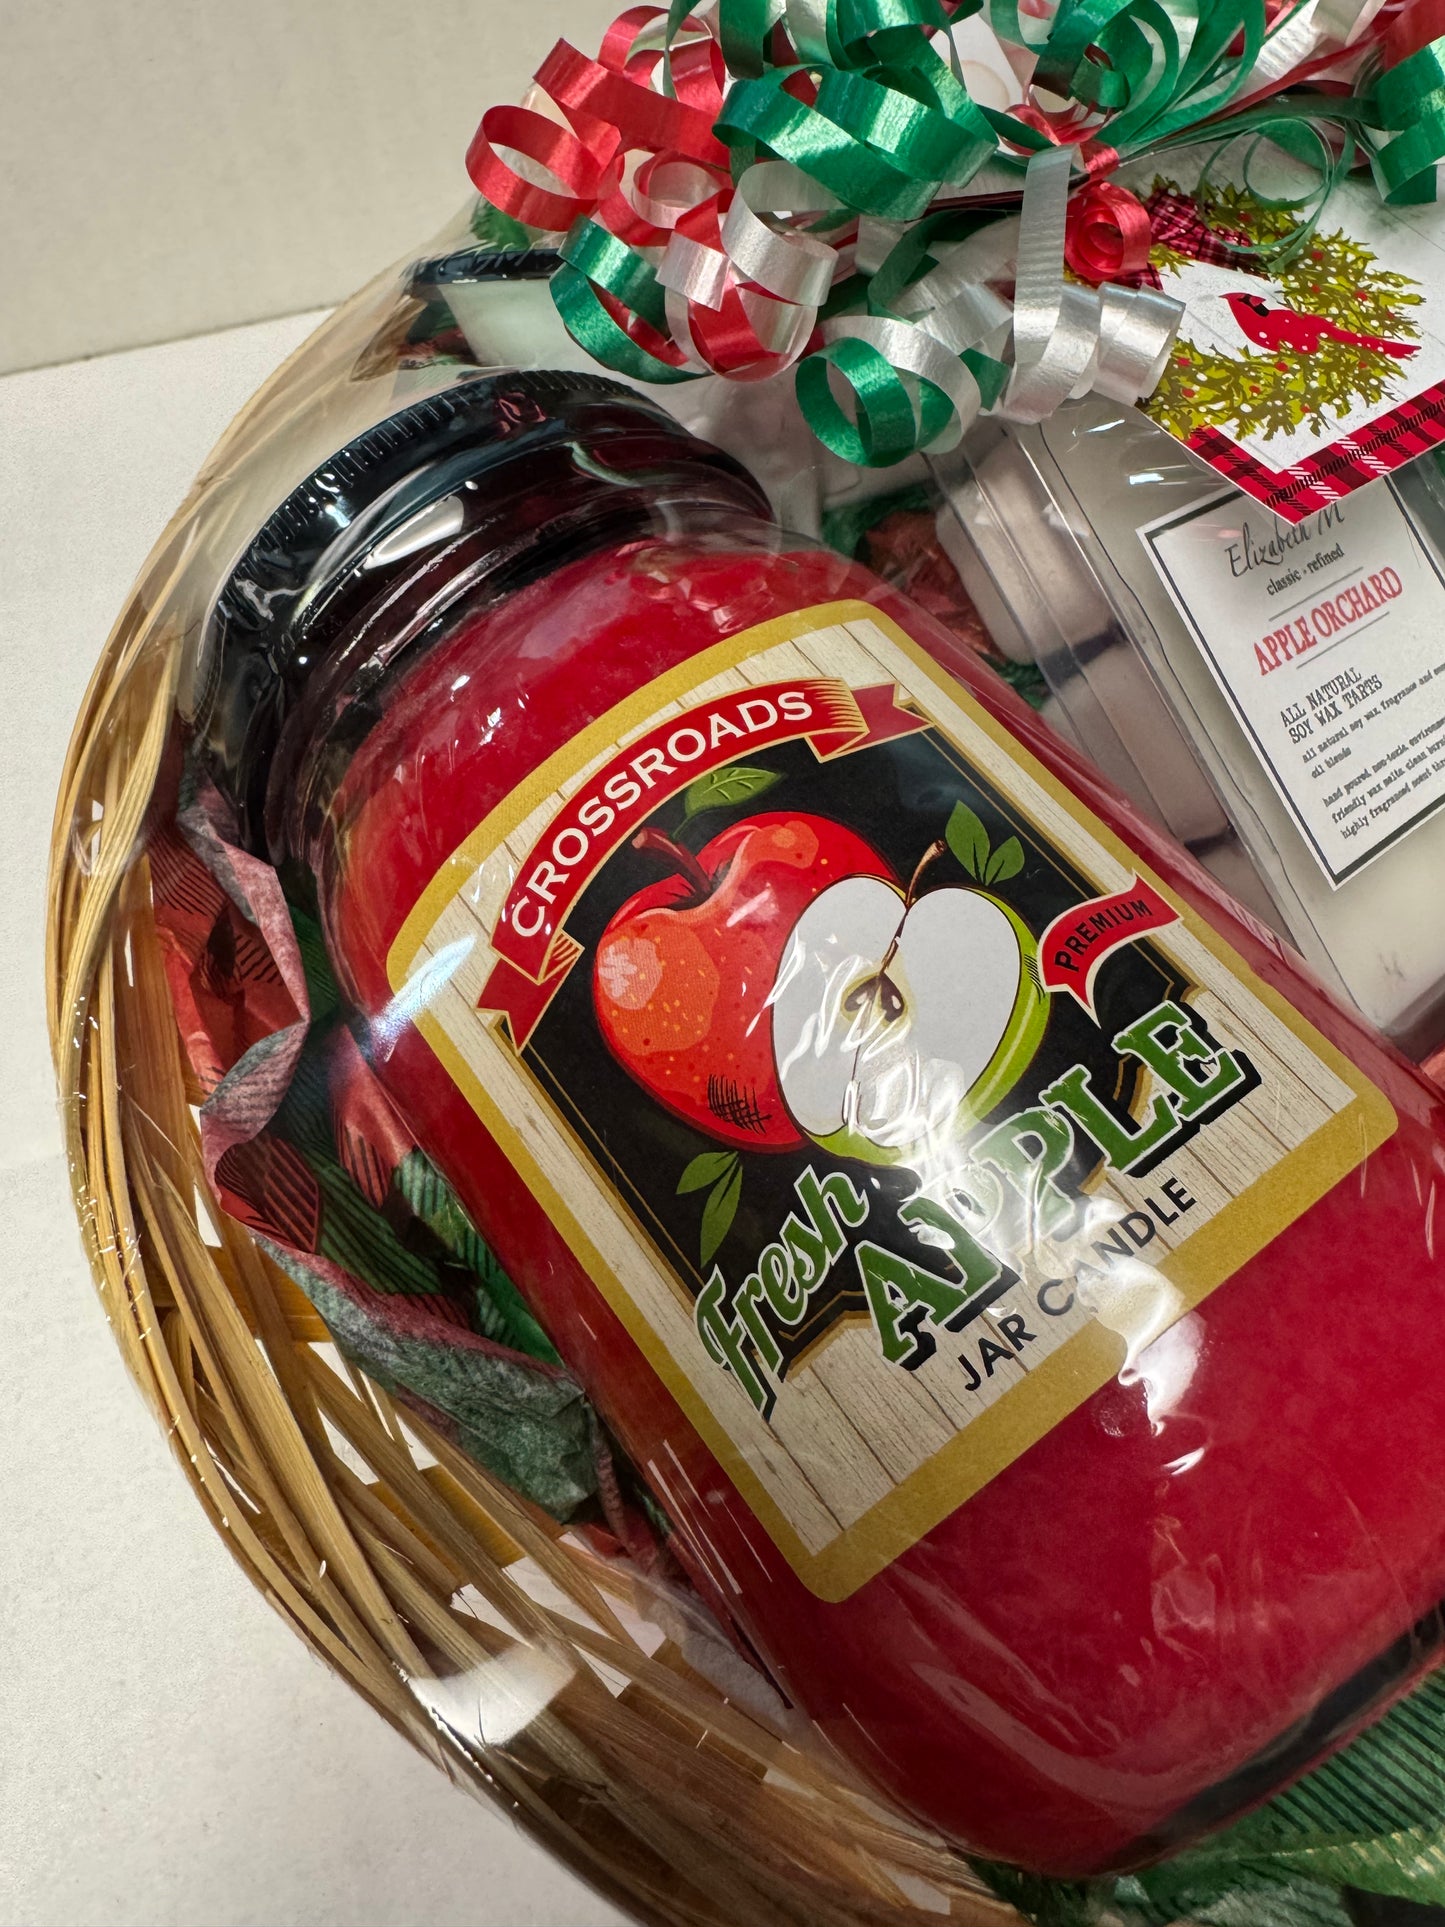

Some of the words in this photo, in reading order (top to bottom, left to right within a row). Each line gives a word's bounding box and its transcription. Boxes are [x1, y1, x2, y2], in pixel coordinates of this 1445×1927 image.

[1267, 568, 1302, 596] classic
[1307, 542, 1345, 574] refined
[1254, 616, 1318, 676] APPLE
[1311, 566, 1403, 638] ORCHARD
[1280, 702, 1307, 727] ALL
[1305, 667, 1362, 711] NATURAL
[1288, 718, 1314, 744] SOY
[1314, 700, 1343, 726] WAX
[1342, 674, 1383, 709] TARTS
[1302, 747, 1317, 763] all
[1317, 727, 1349, 751] natural
[1418, 669, 1433, 685] and
[511, 692, 813, 937] CROSSROADS
[1322, 787, 1344, 807] hand
[1331, 794, 1367, 824] friendly
[1366, 783, 1383, 798] wax
[1340, 815, 1370, 839] highly
[1054, 899, 1153, 972] PREMIUM
[697, 1165, 868, 1420] Fresh
[949, 1314, 1036, 1391] JAR
